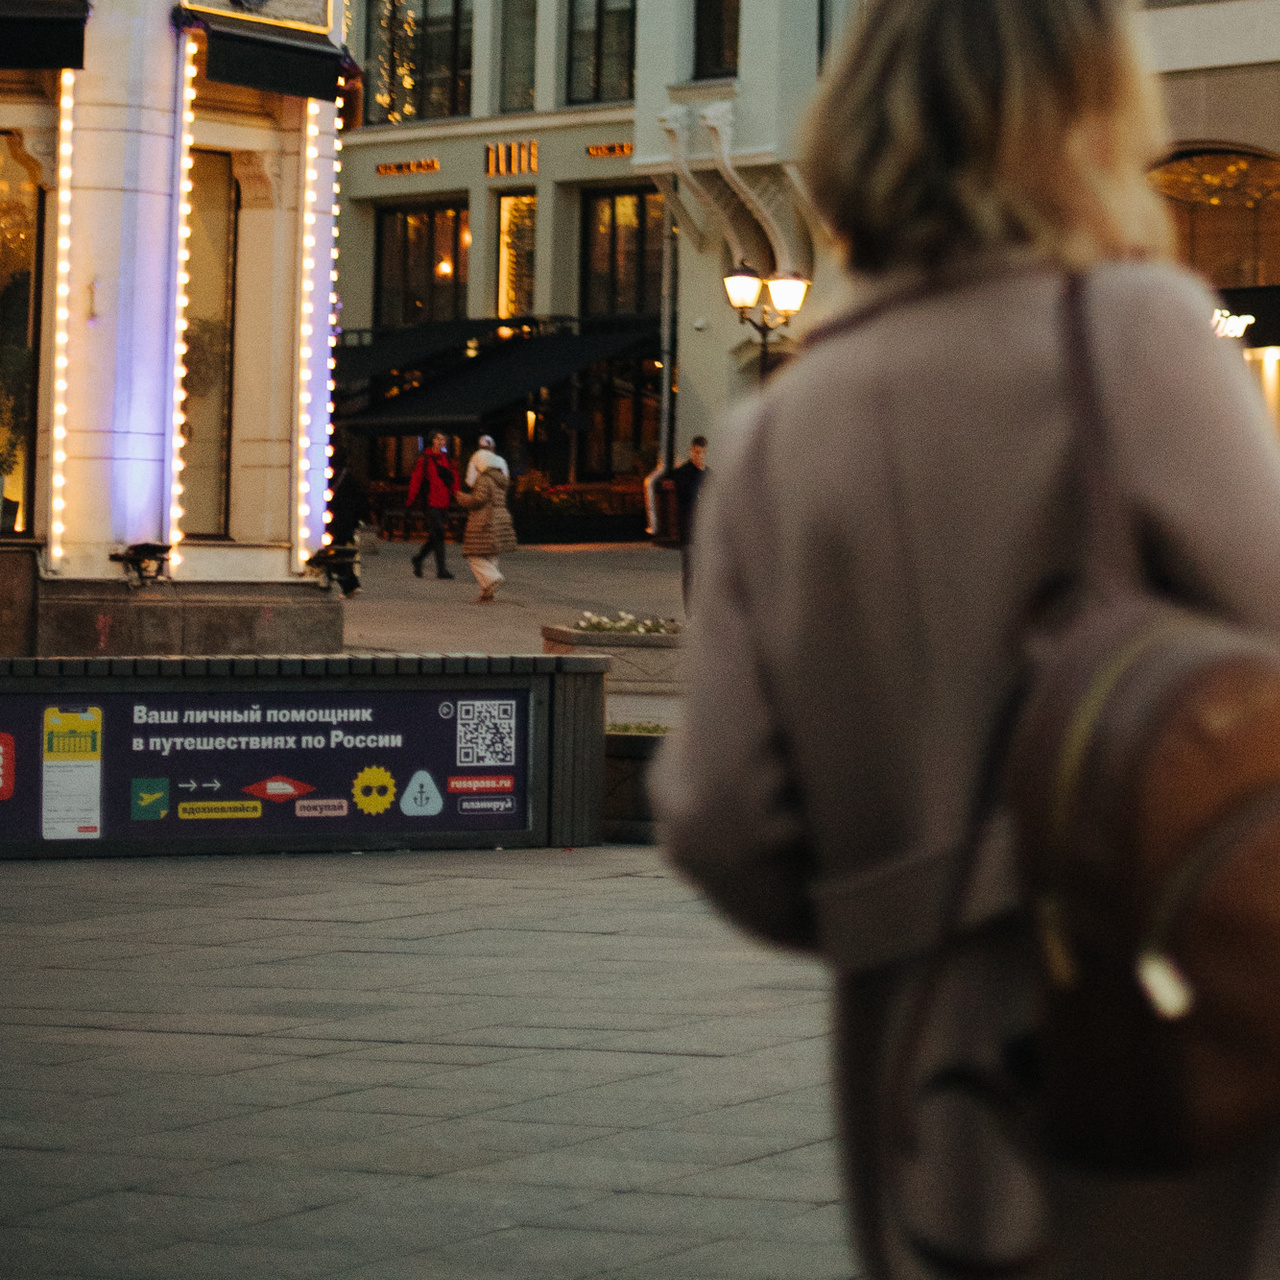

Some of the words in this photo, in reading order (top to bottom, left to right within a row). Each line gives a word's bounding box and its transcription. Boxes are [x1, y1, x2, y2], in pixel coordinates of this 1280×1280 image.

[133, 705, 178, 724] Ваш
[183, 704, 261, 724] личный
[266, 706, 372, 726] помощник
[133, 738, 144, 751] в
[149, 735, 296, 755] путешествиях
[302, 736, 325, 749] по
[330, 730, 402, 749] России
[450, 779, 511, 791] russpass.ru
[299, 802, 344, 815] покупай
